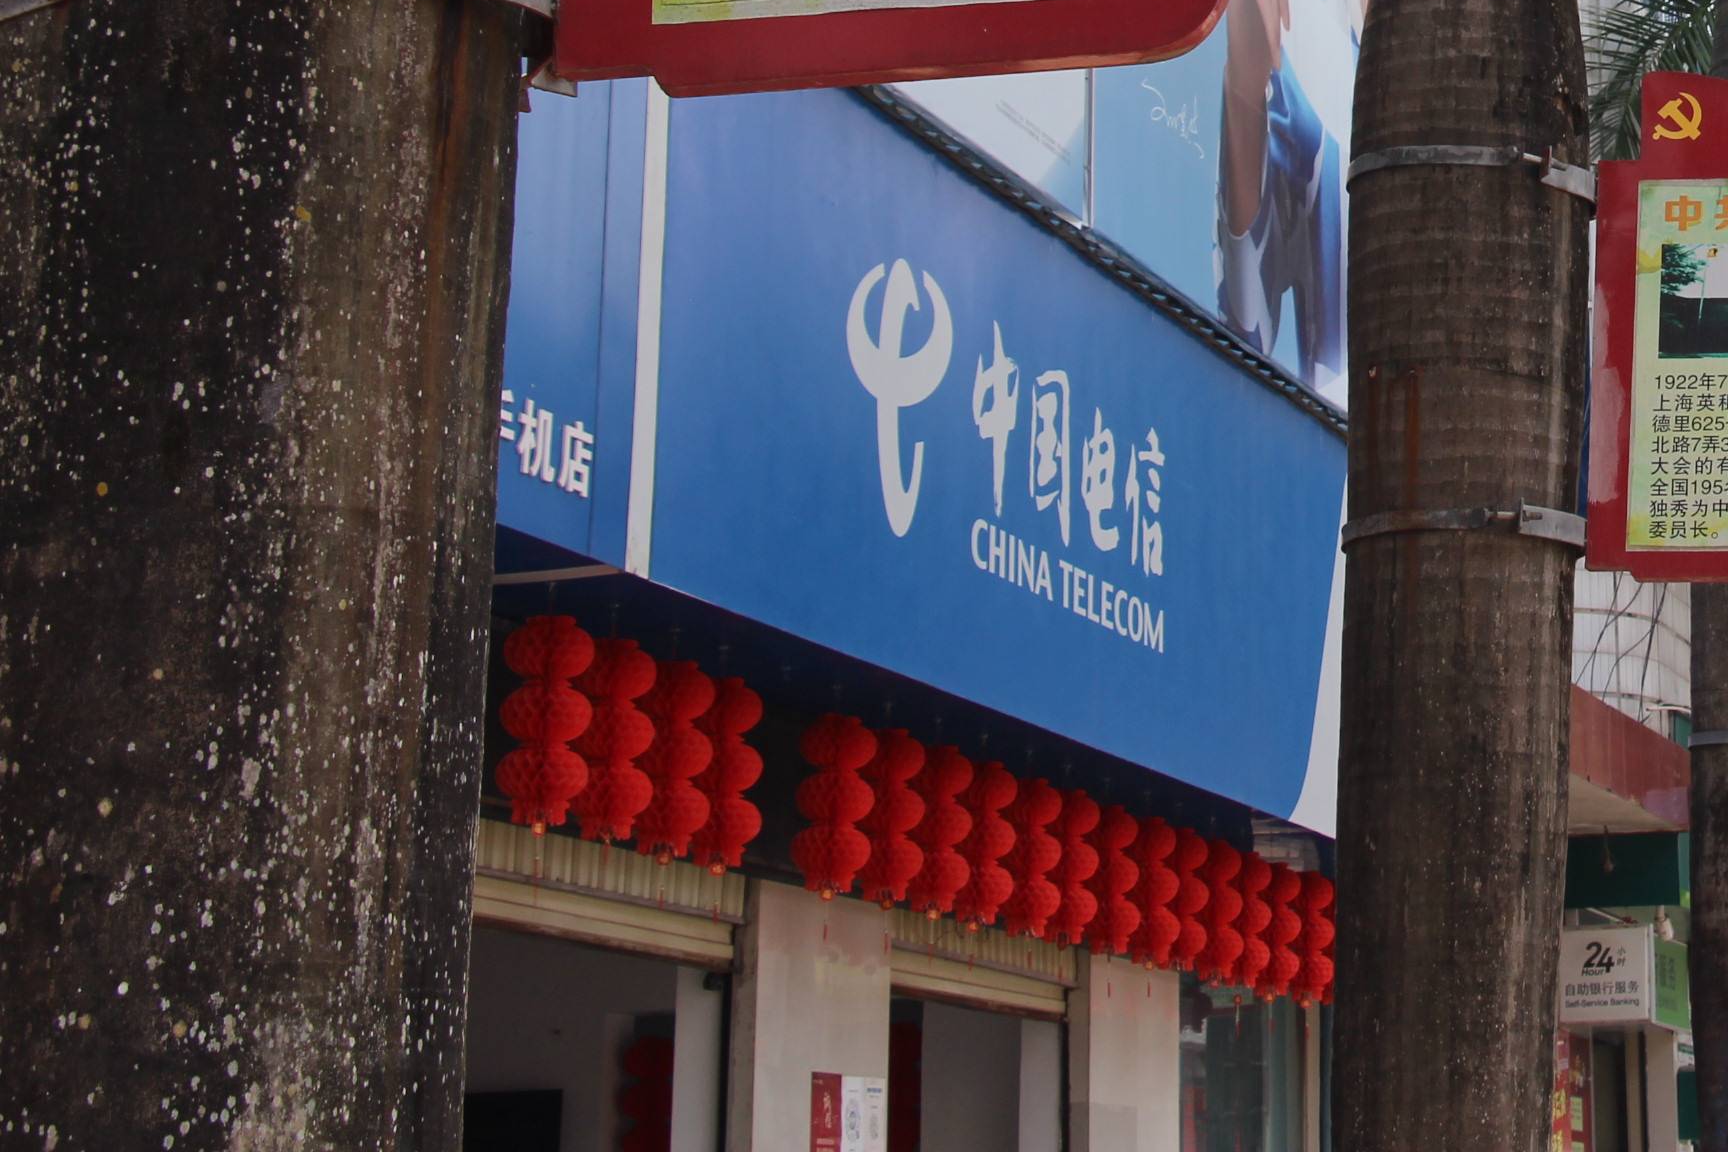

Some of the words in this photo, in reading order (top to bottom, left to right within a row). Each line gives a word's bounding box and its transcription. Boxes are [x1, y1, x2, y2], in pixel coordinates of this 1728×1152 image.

[972, 320, 1165, 577] 中国电信
[1649, 520, 1720, 540] 委员长。
[971, 519, 1053, 601] CHINA
[1059, 559, 1164, 653] TELECOM
[1583, 942, 1615, 973] 24
[1581, 968, 1605, 977] Hour
[1565, 981, 1639, 997] 自助银行服务
